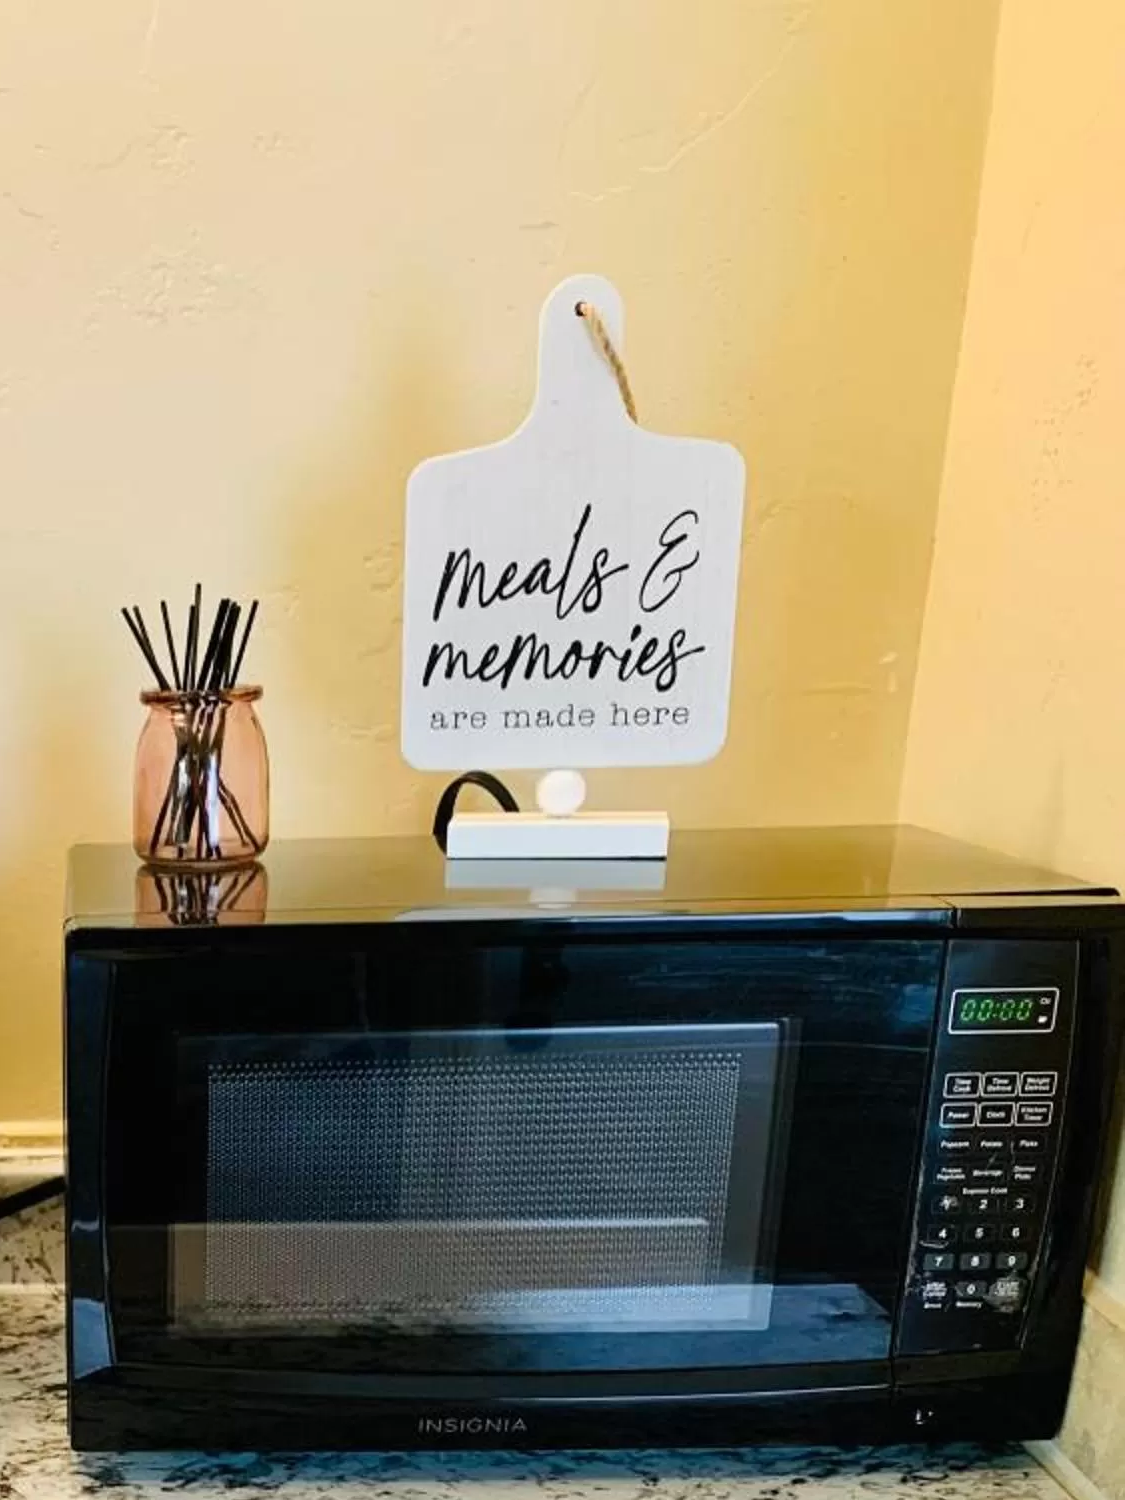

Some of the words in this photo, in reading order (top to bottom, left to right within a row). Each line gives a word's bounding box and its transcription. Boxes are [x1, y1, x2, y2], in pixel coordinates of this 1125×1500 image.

[433, 503, 629, 622] meals
[639, 509, 699, 613] &
[422, 624, 705, 692] memories
[430, 708, 487, 730] are
[503, 704, 596, 729] made
[610, 701, 690, 727] here
[979, 1199, 988, 1210] 2
[1015, 1198, 1024, 1210] 3
[938, 1228, 947, 1238] 4
[1011, 1227, 1020, 1238] 6
[935, 1256, 944, 1267] 7
[417, 1416, 528, 1433] INSIGNIA
